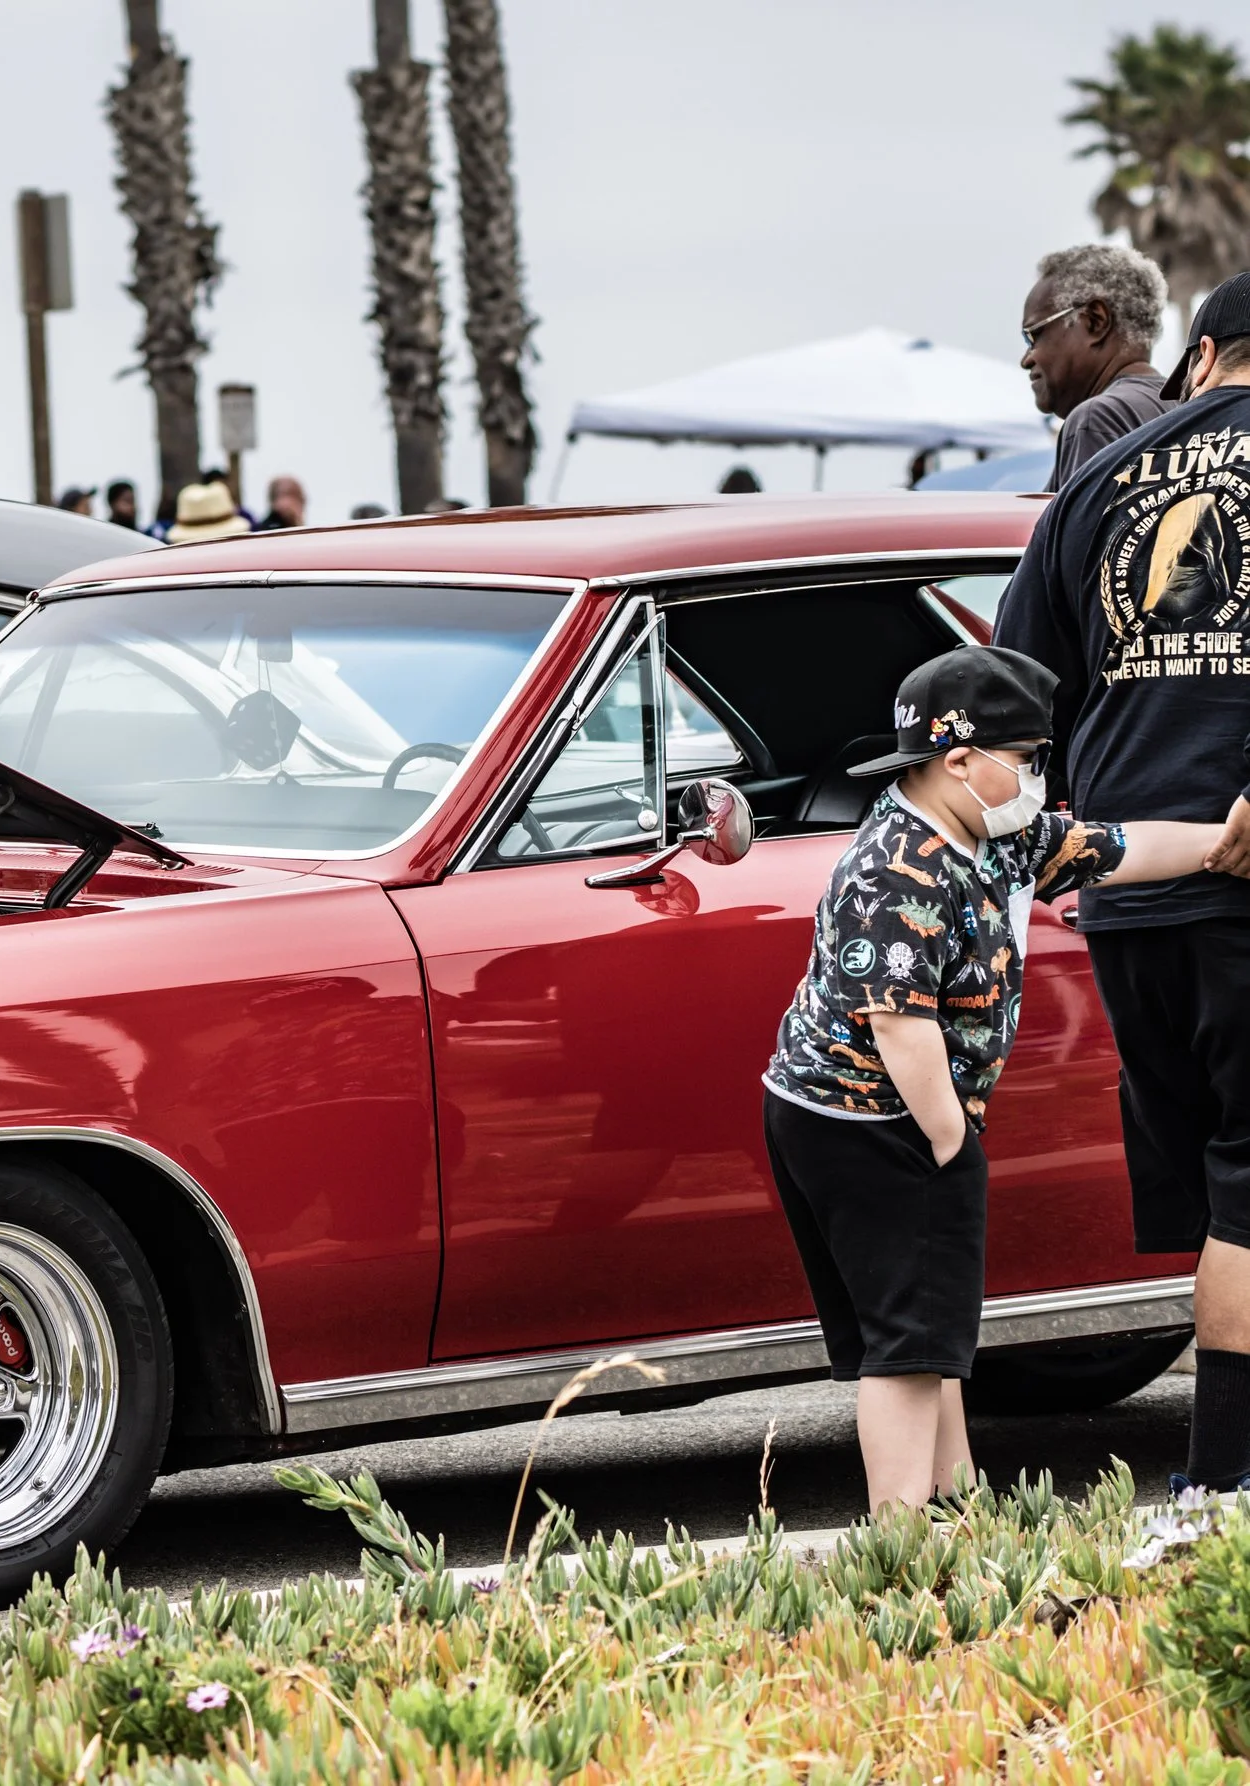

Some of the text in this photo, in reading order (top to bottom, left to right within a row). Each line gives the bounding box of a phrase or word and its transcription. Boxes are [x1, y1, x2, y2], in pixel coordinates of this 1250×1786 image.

[1128, 471, 1250, 520] I HAVE 3 SIDES
[1218, 493, 1241, 517] THE
[1233, 515, 1250, 541] FUN
[1115, 535, 1139, 578] SWEET
[1134, 511, 1159, 536] SIDE
[1212, 599, 1241, 628] SIDE
[1149, 633, 1189, 655] THE
[1193, 632, 1243, 654] SIDE
[1165, 658, 1204, 677] WANT
[1209, 657, 1228, 675] TO
[1232, 657, 1250, 675] SE
